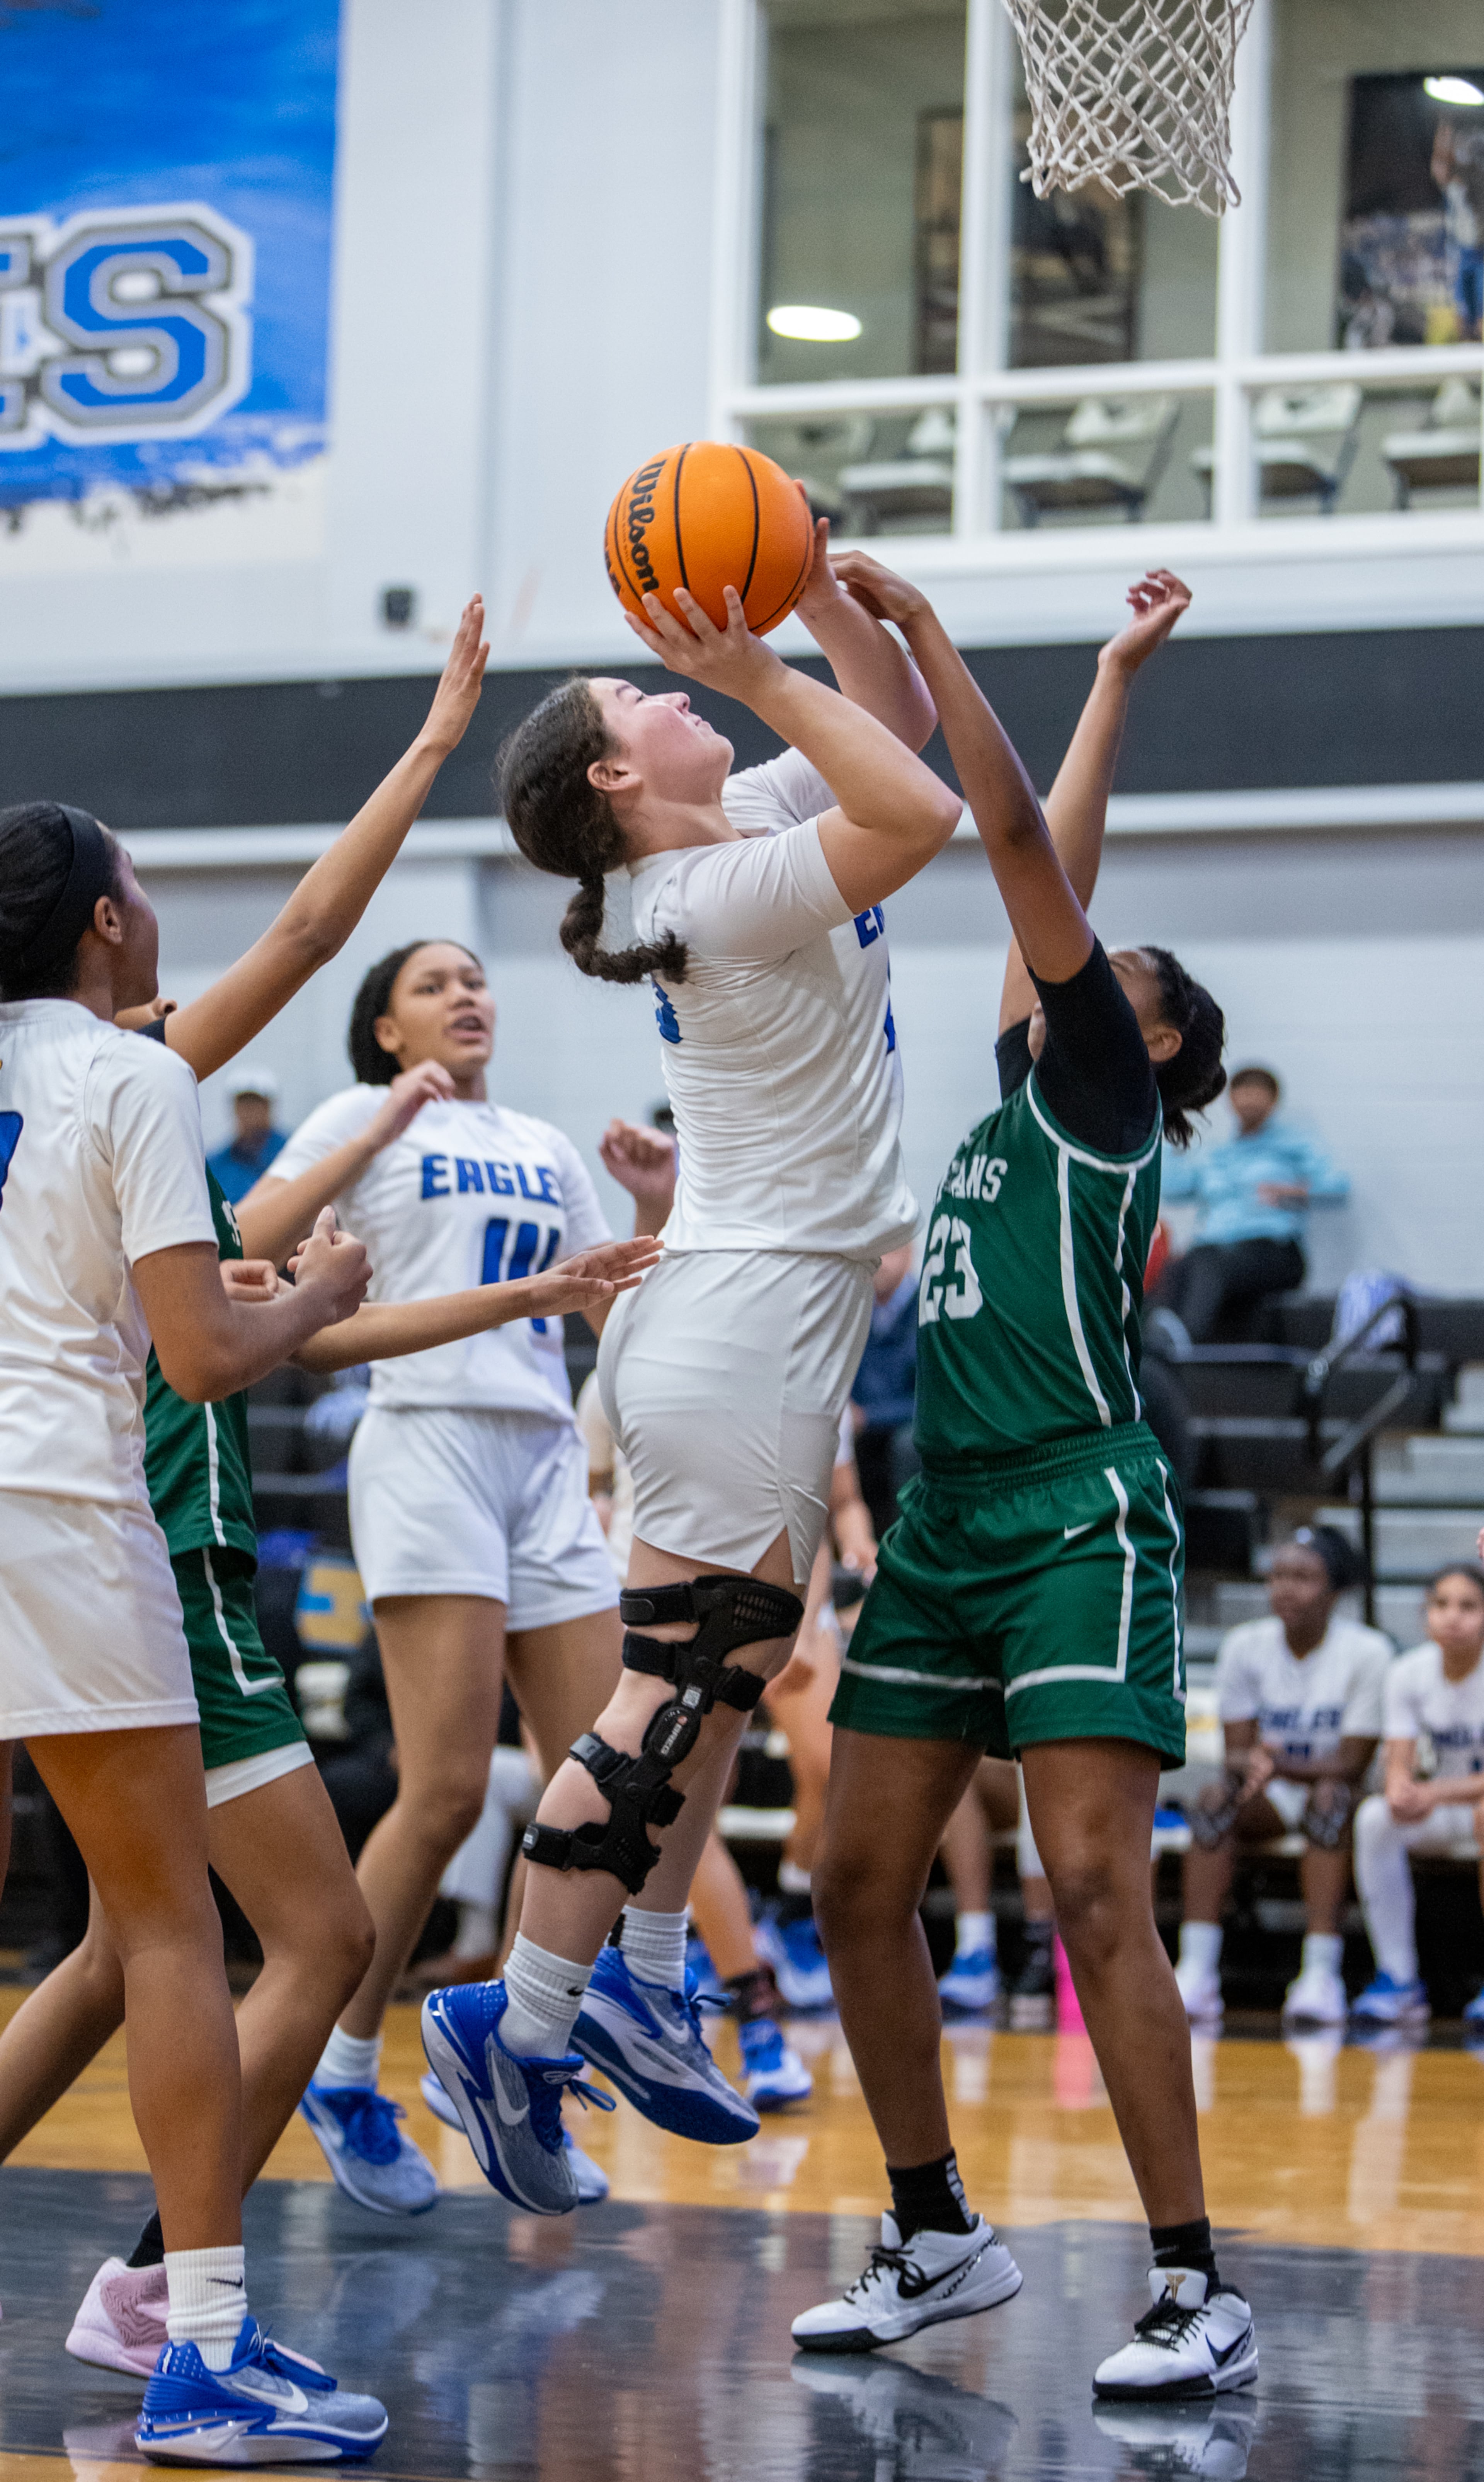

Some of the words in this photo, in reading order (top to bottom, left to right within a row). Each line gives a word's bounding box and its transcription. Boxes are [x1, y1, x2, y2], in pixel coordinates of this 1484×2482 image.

[0, 203, 253, 451] S
[628, 459, 667, 593] Wilson
[421, 1154, 561, 1206] EAGLE
[935, 1154, 1008, 1203] ANS
[919, 1214, 983, 1327] 23
